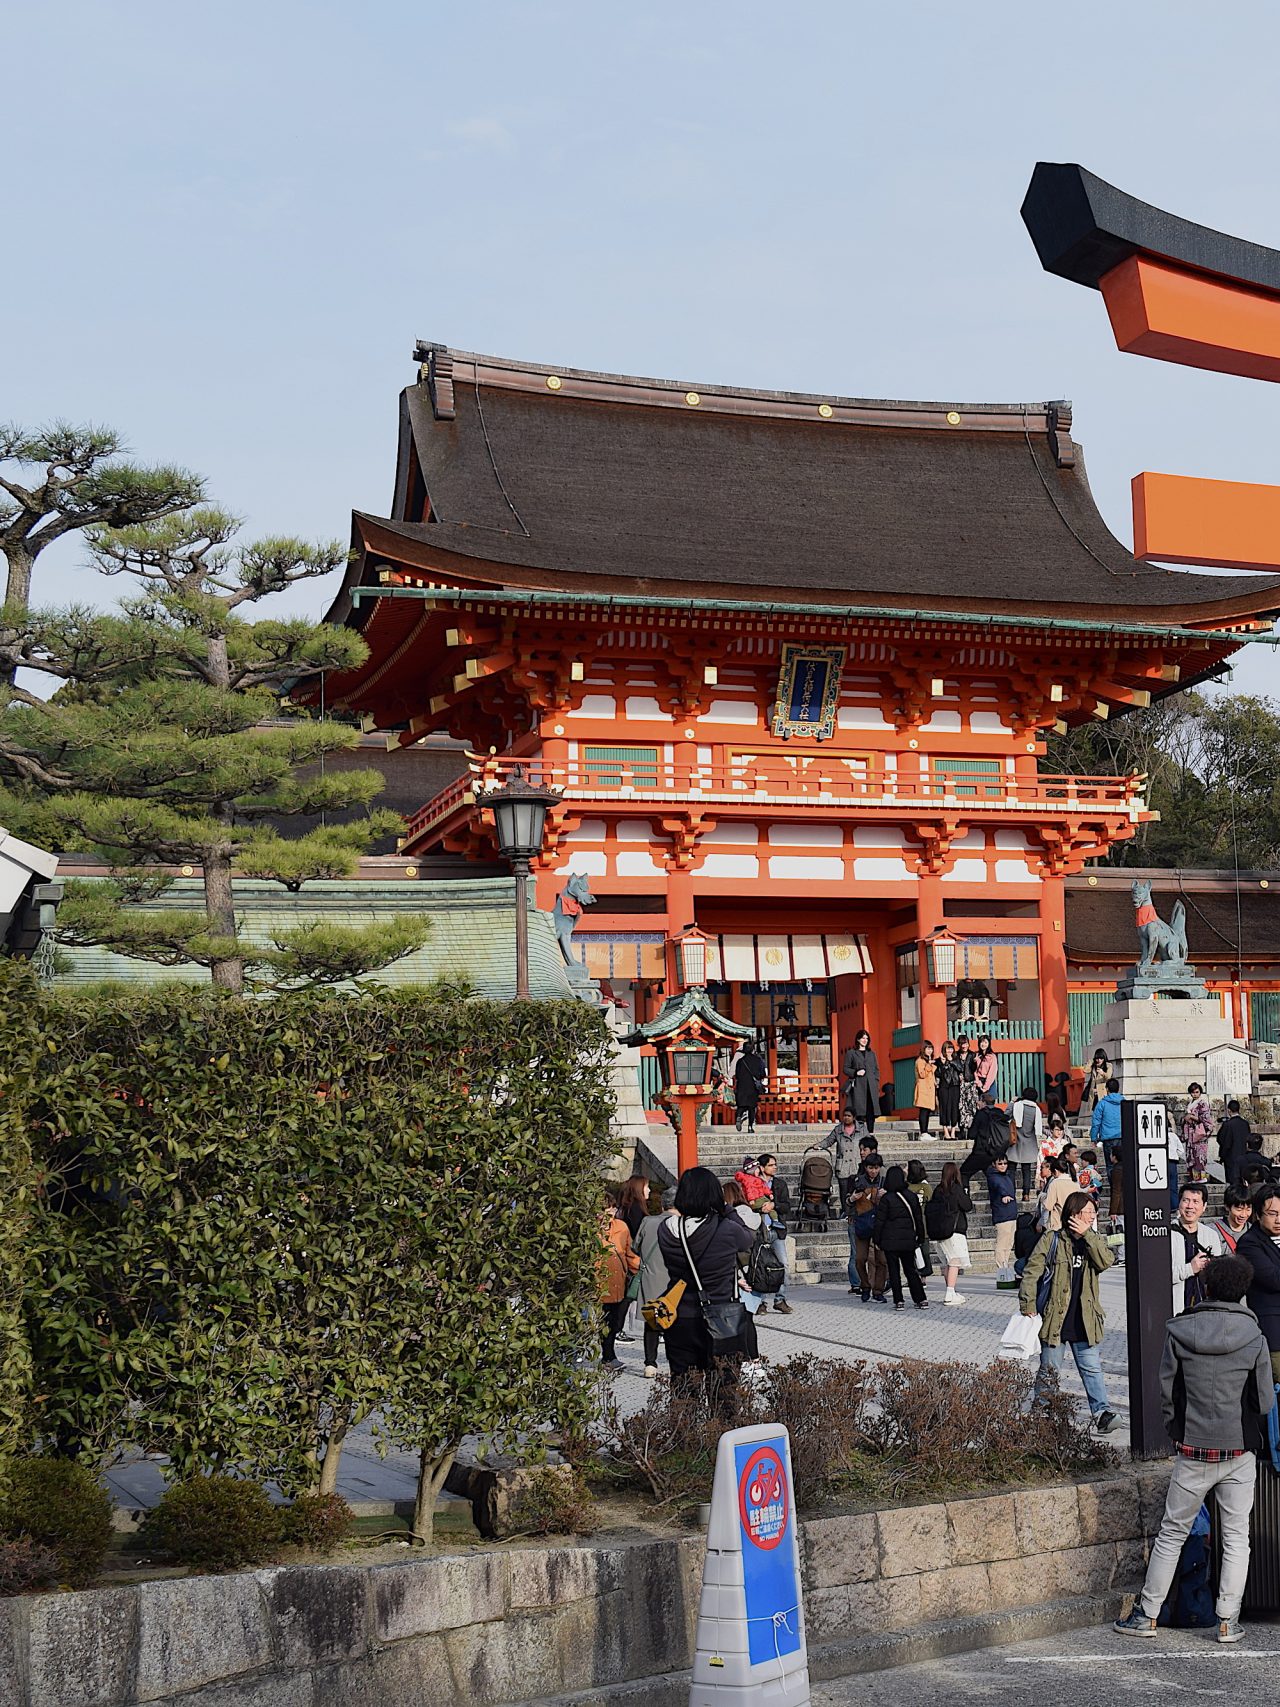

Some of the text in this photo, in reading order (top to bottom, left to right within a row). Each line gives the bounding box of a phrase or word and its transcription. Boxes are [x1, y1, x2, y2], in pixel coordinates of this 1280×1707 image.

[1144, 1207, 1163, 1220] Rest
[1142, 1224, 1168, 1237] Room
[750, 1502, 784, 1527] 駐輪禁止
